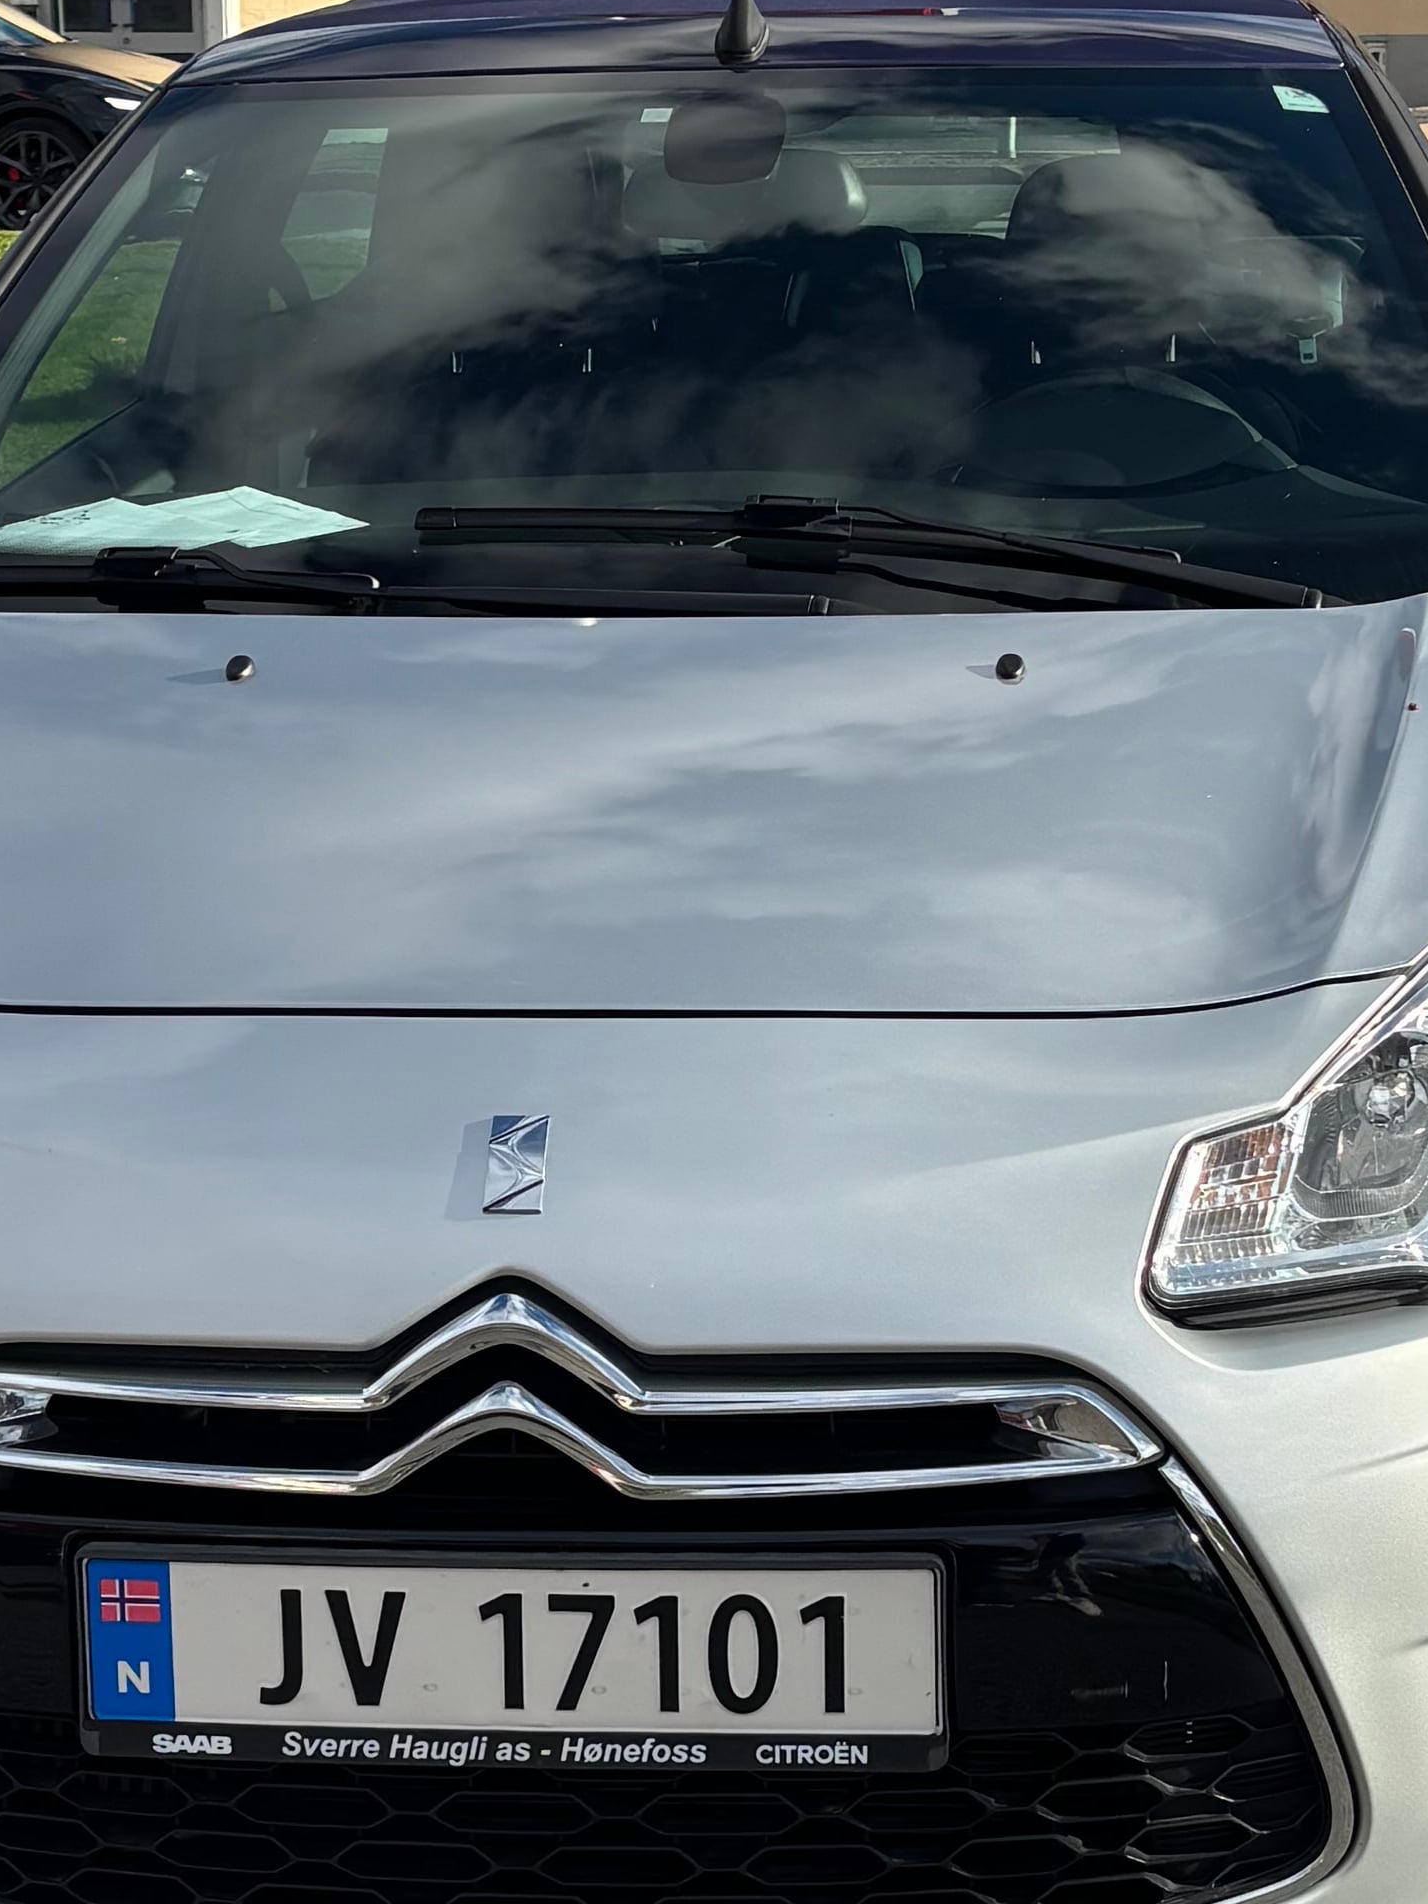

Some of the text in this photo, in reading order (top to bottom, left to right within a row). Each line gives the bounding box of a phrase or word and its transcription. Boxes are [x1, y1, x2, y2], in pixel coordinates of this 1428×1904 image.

[259, 1587, 848, 1715] JV 17101
[116, 1660, 150, 1695] N
[152, 1733, 233, 1755] SAAB
[282, 1731, 380, 1758] Sverre
[389, 1733, 489, 1767] Haugli
[495, 1741, 532, 1762] as
[559, 1737, 708, 1765] Hønefoss
[755, 1740, 869, 1765] CITROËN
